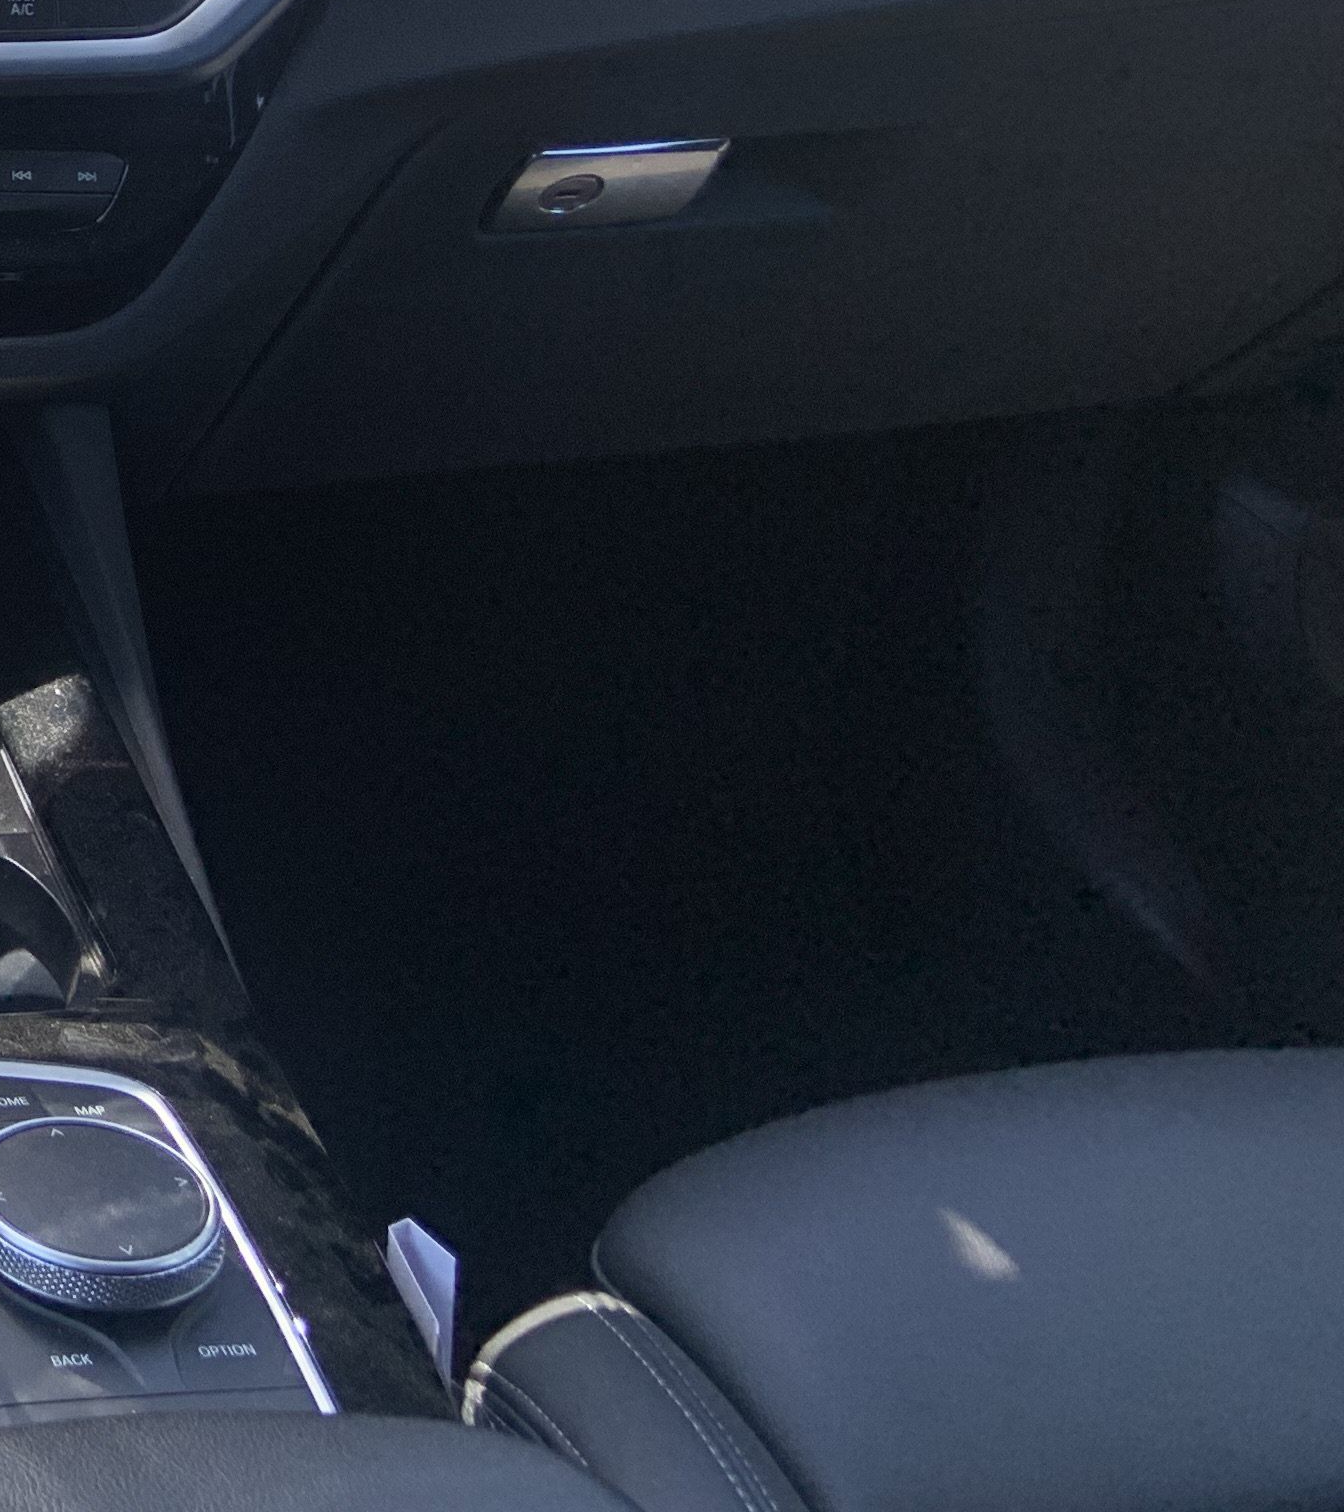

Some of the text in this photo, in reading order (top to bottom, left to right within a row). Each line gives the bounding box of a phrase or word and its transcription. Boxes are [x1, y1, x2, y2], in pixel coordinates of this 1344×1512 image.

[11, 3, 34, 16] A/C
[73, 1105, 105, 1117] MAP
[197, 1343, 257, 1359] OPTION
[50, 1353, 93, 1368] BACK
